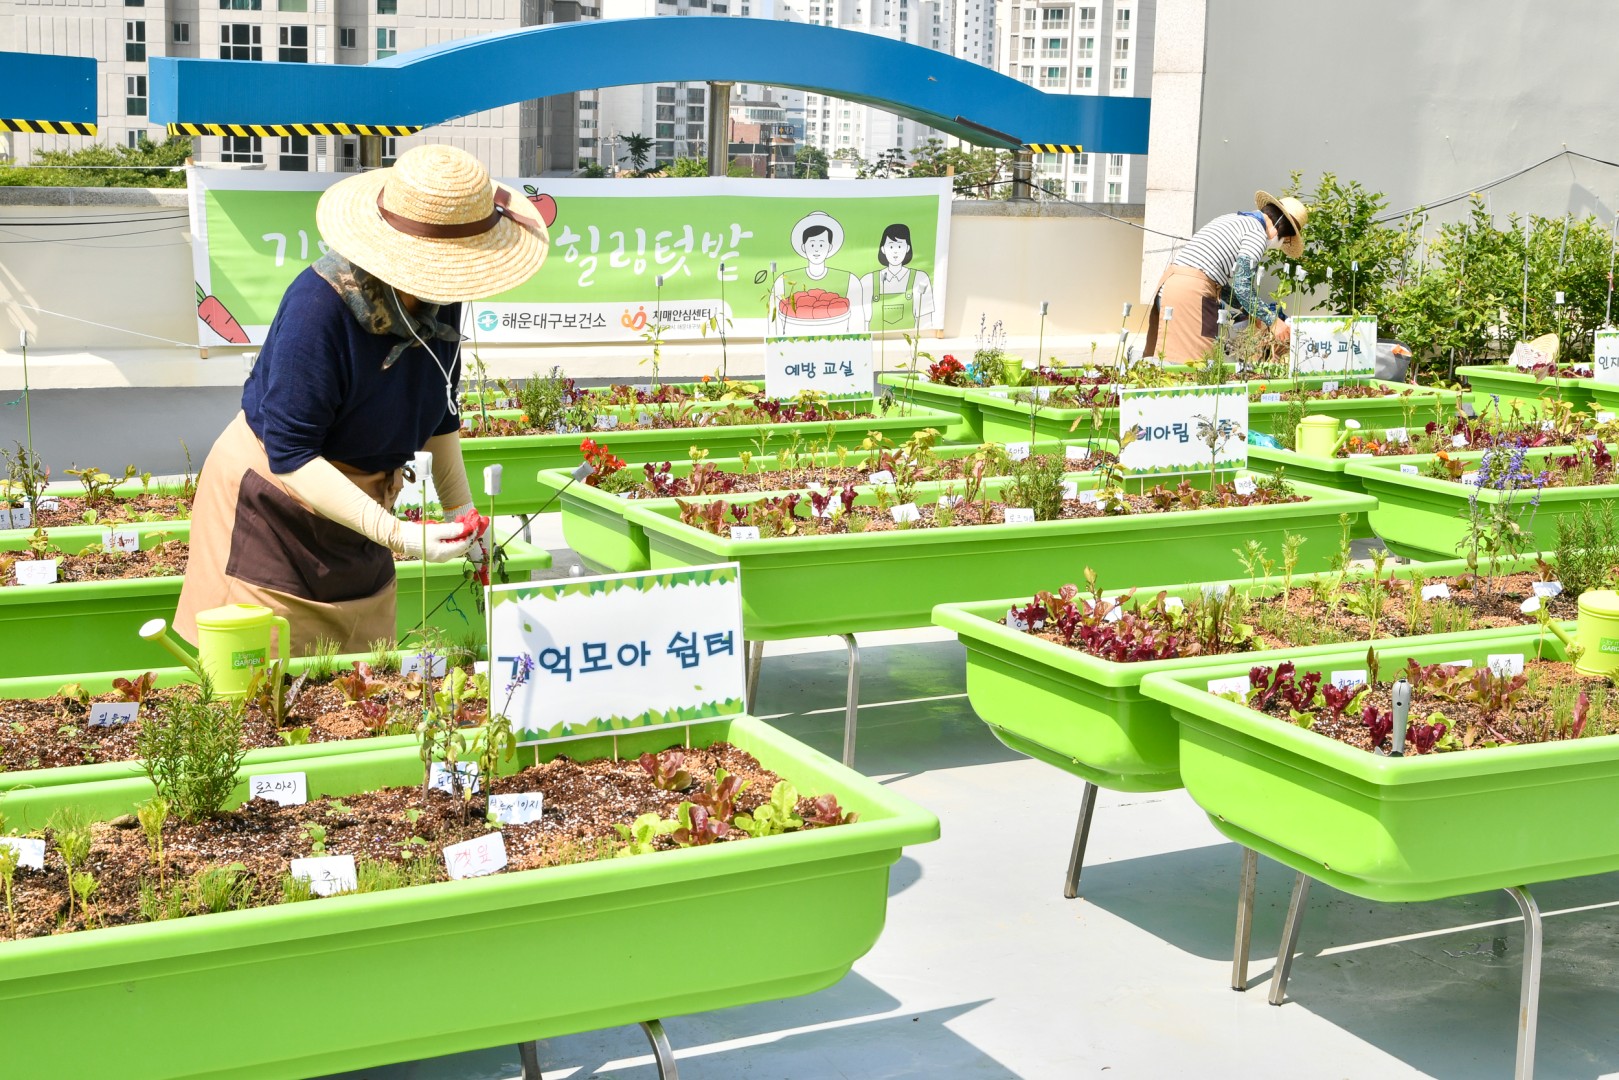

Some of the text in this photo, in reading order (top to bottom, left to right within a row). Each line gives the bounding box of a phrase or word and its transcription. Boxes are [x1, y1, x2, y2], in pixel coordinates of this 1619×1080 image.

[502, 312, 607, 329] 해운대구보건소
[653, 308, 711, 322] 치매안심센터
[1306, 340, 1332, 356] 예방
[784, 360, 855, 379] 예방 교실
[497, 630, 735, 682] 기억모아 쉼터
[256, 780, 297, 795] 로즈마리
[455, 844, 492, 868] 깻잎
